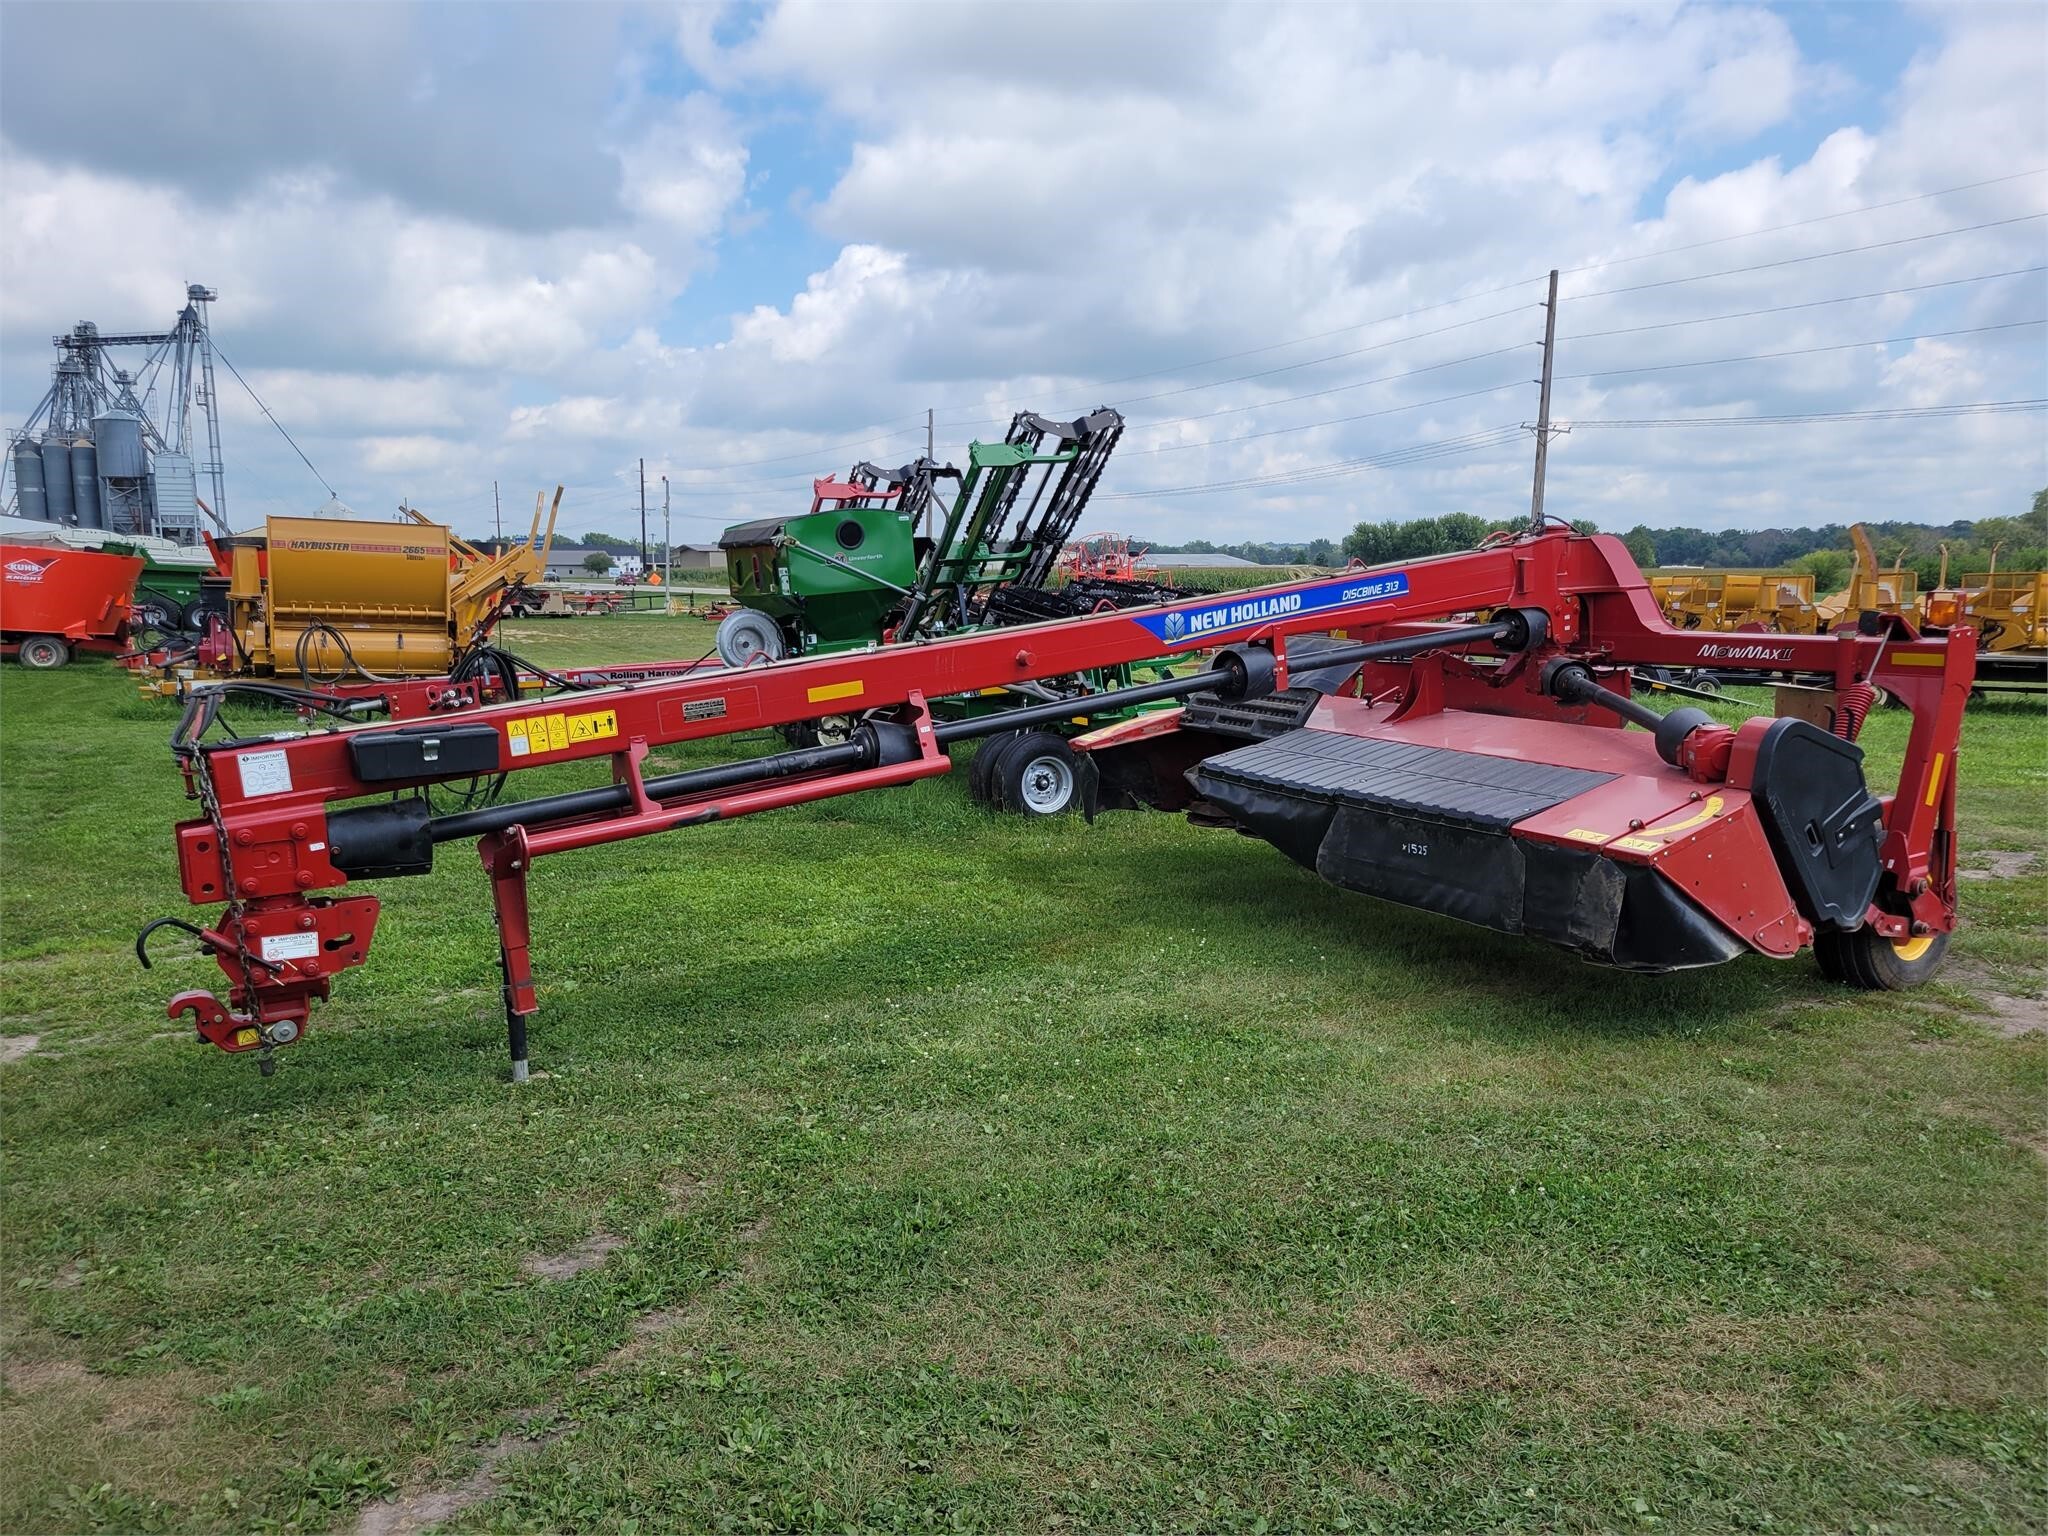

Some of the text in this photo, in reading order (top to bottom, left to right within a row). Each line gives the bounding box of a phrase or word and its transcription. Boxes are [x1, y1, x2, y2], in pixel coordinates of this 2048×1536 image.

[291, 541, 350, 551] HAYBUSTER
[402, 546, 426, 554] 2665
[1342, 581, 1399, 601] DISCBINE 313
[1190, 594, 1301, 632] NEW HOLLAND
[610, 669, 684, 680] Rolling Harrow
